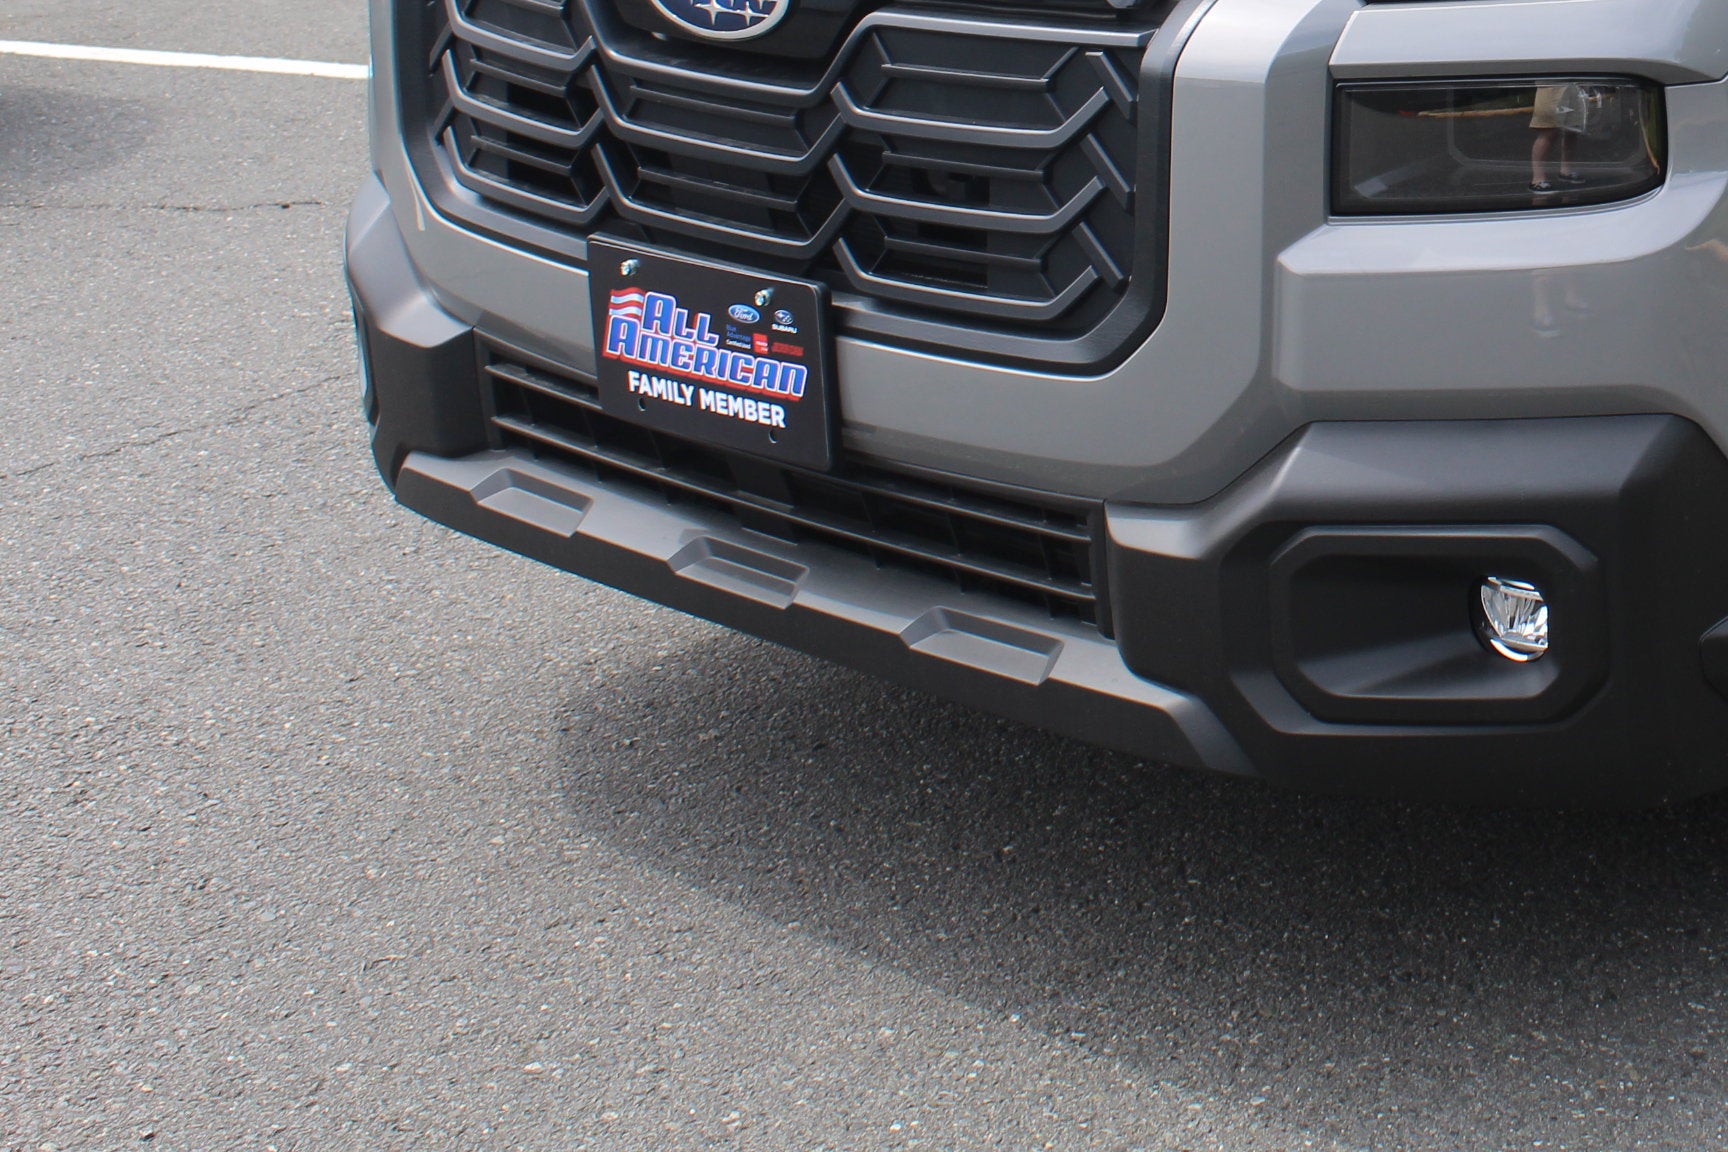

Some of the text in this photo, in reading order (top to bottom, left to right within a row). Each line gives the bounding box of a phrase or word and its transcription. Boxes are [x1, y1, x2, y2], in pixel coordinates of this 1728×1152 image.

[604, 315, 808, 400] AMERICAN
[771, 323, 798, 335] SUBARU
[628, 370, 786, 429] FAMILY MEMBER
